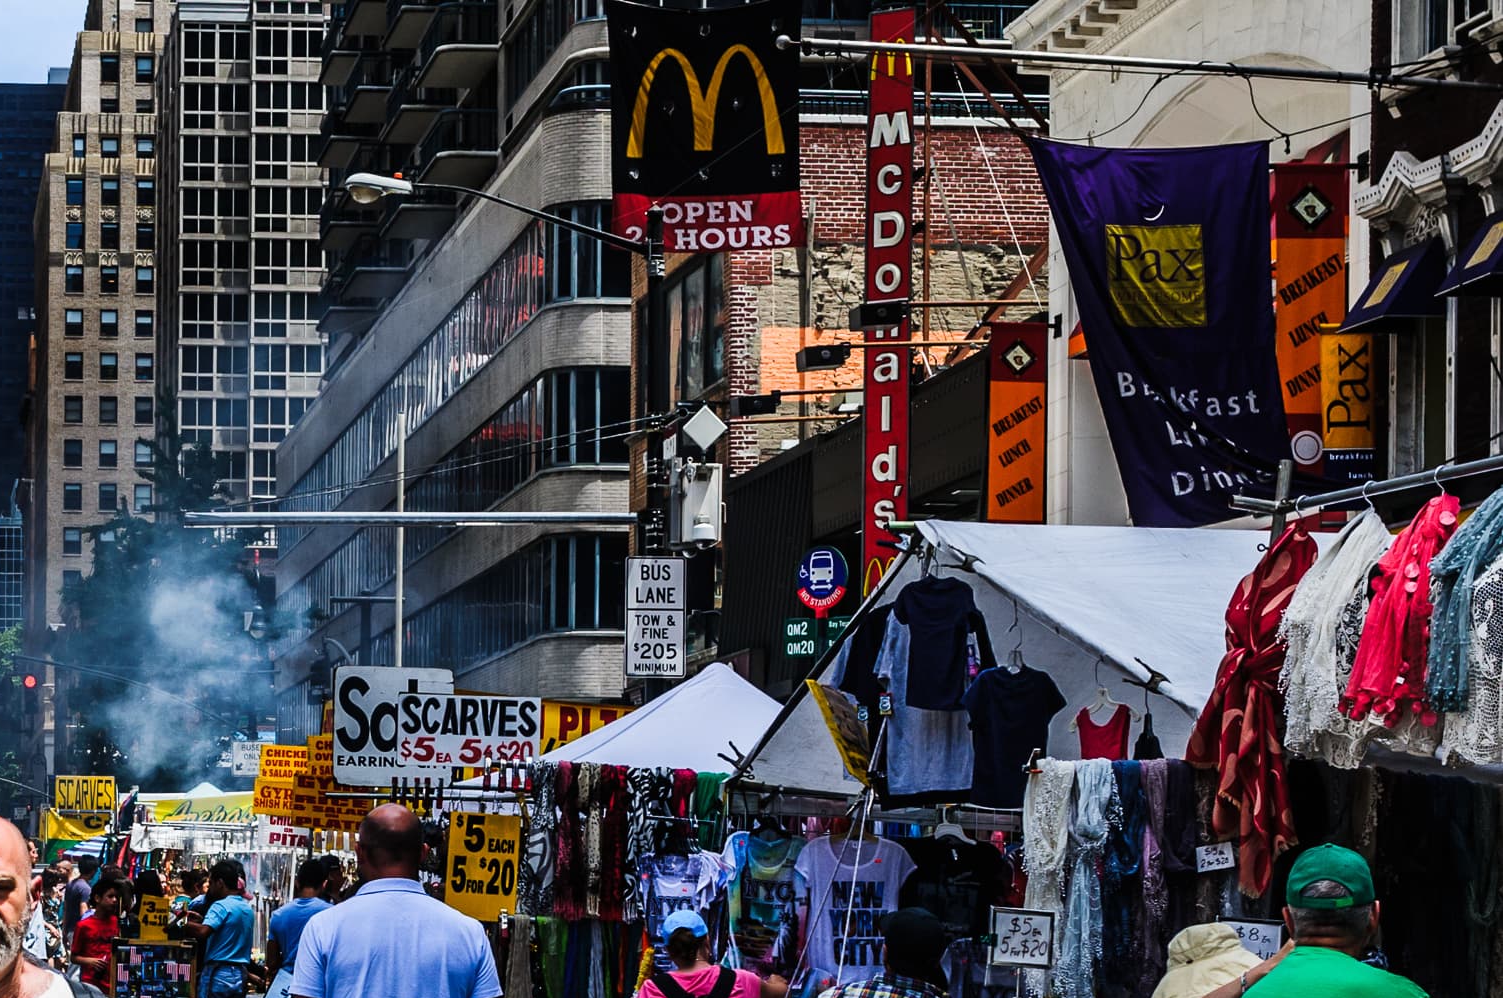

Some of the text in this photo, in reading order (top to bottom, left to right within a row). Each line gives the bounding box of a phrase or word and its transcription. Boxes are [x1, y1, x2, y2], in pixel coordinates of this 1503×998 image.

[663, 200, 753, 223] OPEN
[675, 224, 791, 250] HOURS
[1109, 233, 1199, 283] Pax
[1278, 252, 1344, 306] BREAKFAST
[869, 110, 911, 531] McDoald's
[1288, 310, 1329, 348] LUNCH
[1326, 341, 1371, 435] Pax
[992, 396, 1044, 438] BREAKFAST
[998, 438, 1032, 469] LUNCH
[1348, 471, 1374, 479] lunch
[996, 476, 1034, 508] DINNER
[640, 564, 672, 581] BUS
[635, 587, 676, 604] LANE
[800, 589, 842, 607] NO STANDING
[634, 614, 676, 627] TOW &
[787, 621, 808, 636] QM2
[641, 627, 669, 640] FINE
[633, 642, 677, 660] $205
[787, 640, 815, 655] QM20
[633, 662, 677, 673] MINIMUM
[400, 695, 538, 738] SCARVES
[241, 743, 260, 751] BUSE
[266, 748, 308, 759] CHICKE
[400, 736, 435, 763] $5
[435, 752, 453, 763] EA
[459, 739, 483, 765] 5
[265, 759, 291, 768] OVER
[269, 769, 292, 778] SALAD
[58, 779, 113, 810] SCARVES
[253, 798, 280, 809] SHISH
[268, 832, 308, 848] PITA
[456, 814, 515, 854] $5 EACH
[451, 855, 515, 896] 5 FOR $20
[831, 880, 885, 908] NEW
[829, 909, 888, 937] YORK
[1008, 917, 1033, 936] $5
[1236, 926, 1260, 942] $8
[833, 938, 884, 967] CITY
[1000, 936, 1011, 953] 5
[1020, 939, 1048, 958] $20
